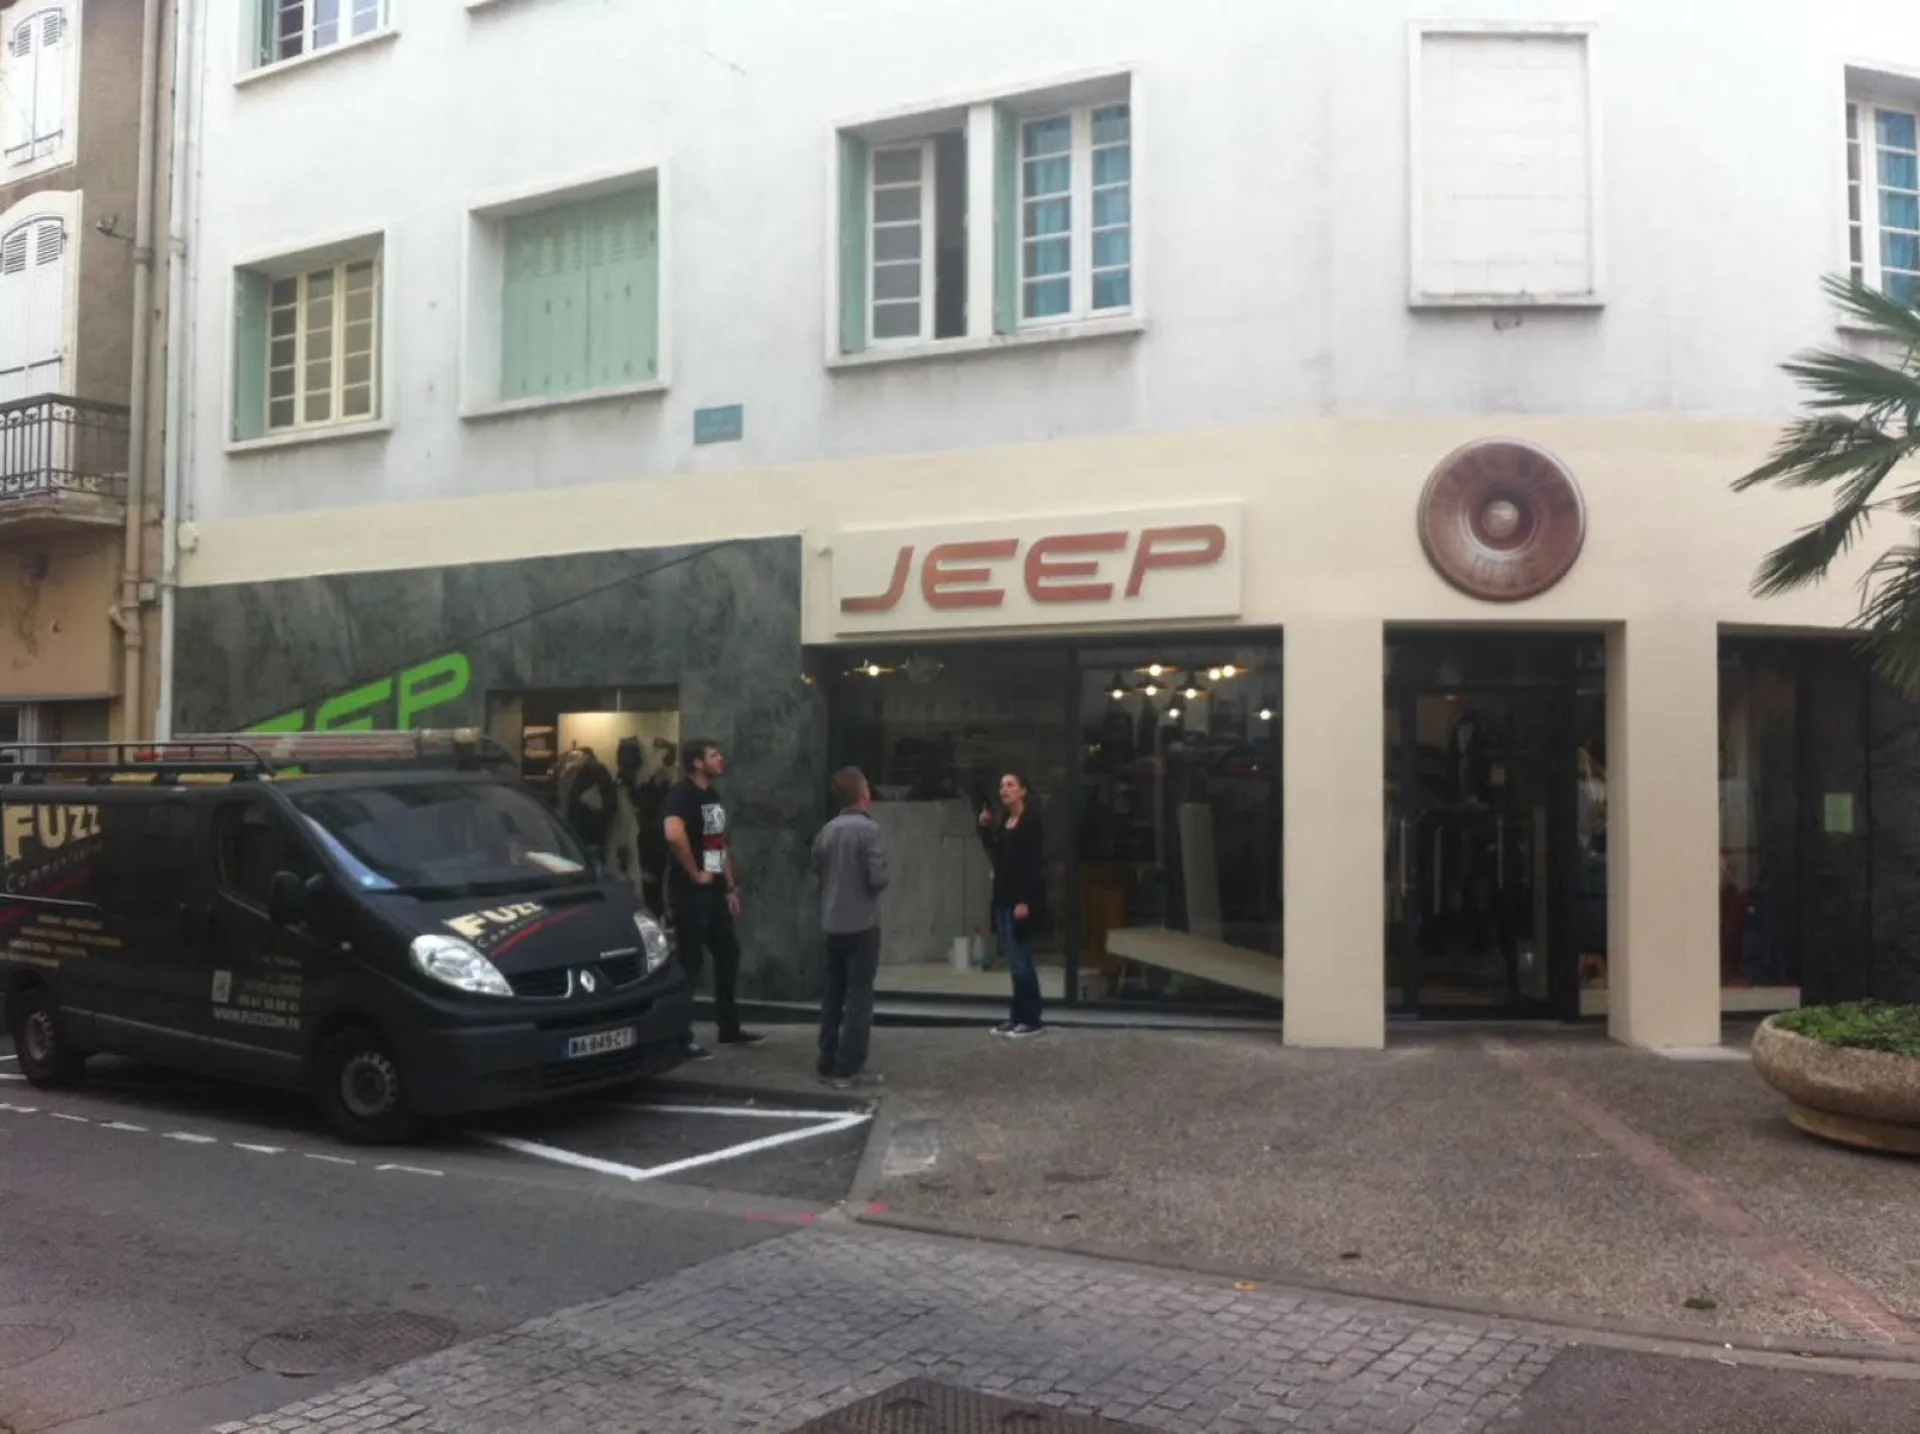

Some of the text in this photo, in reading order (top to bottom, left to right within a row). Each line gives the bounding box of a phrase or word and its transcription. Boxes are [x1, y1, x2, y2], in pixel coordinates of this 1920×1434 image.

[841, 524, 1226, 613] JEEP
[4, 804, 101, 862] FUZZ
[442, 902, 543, 939] FUZZ
